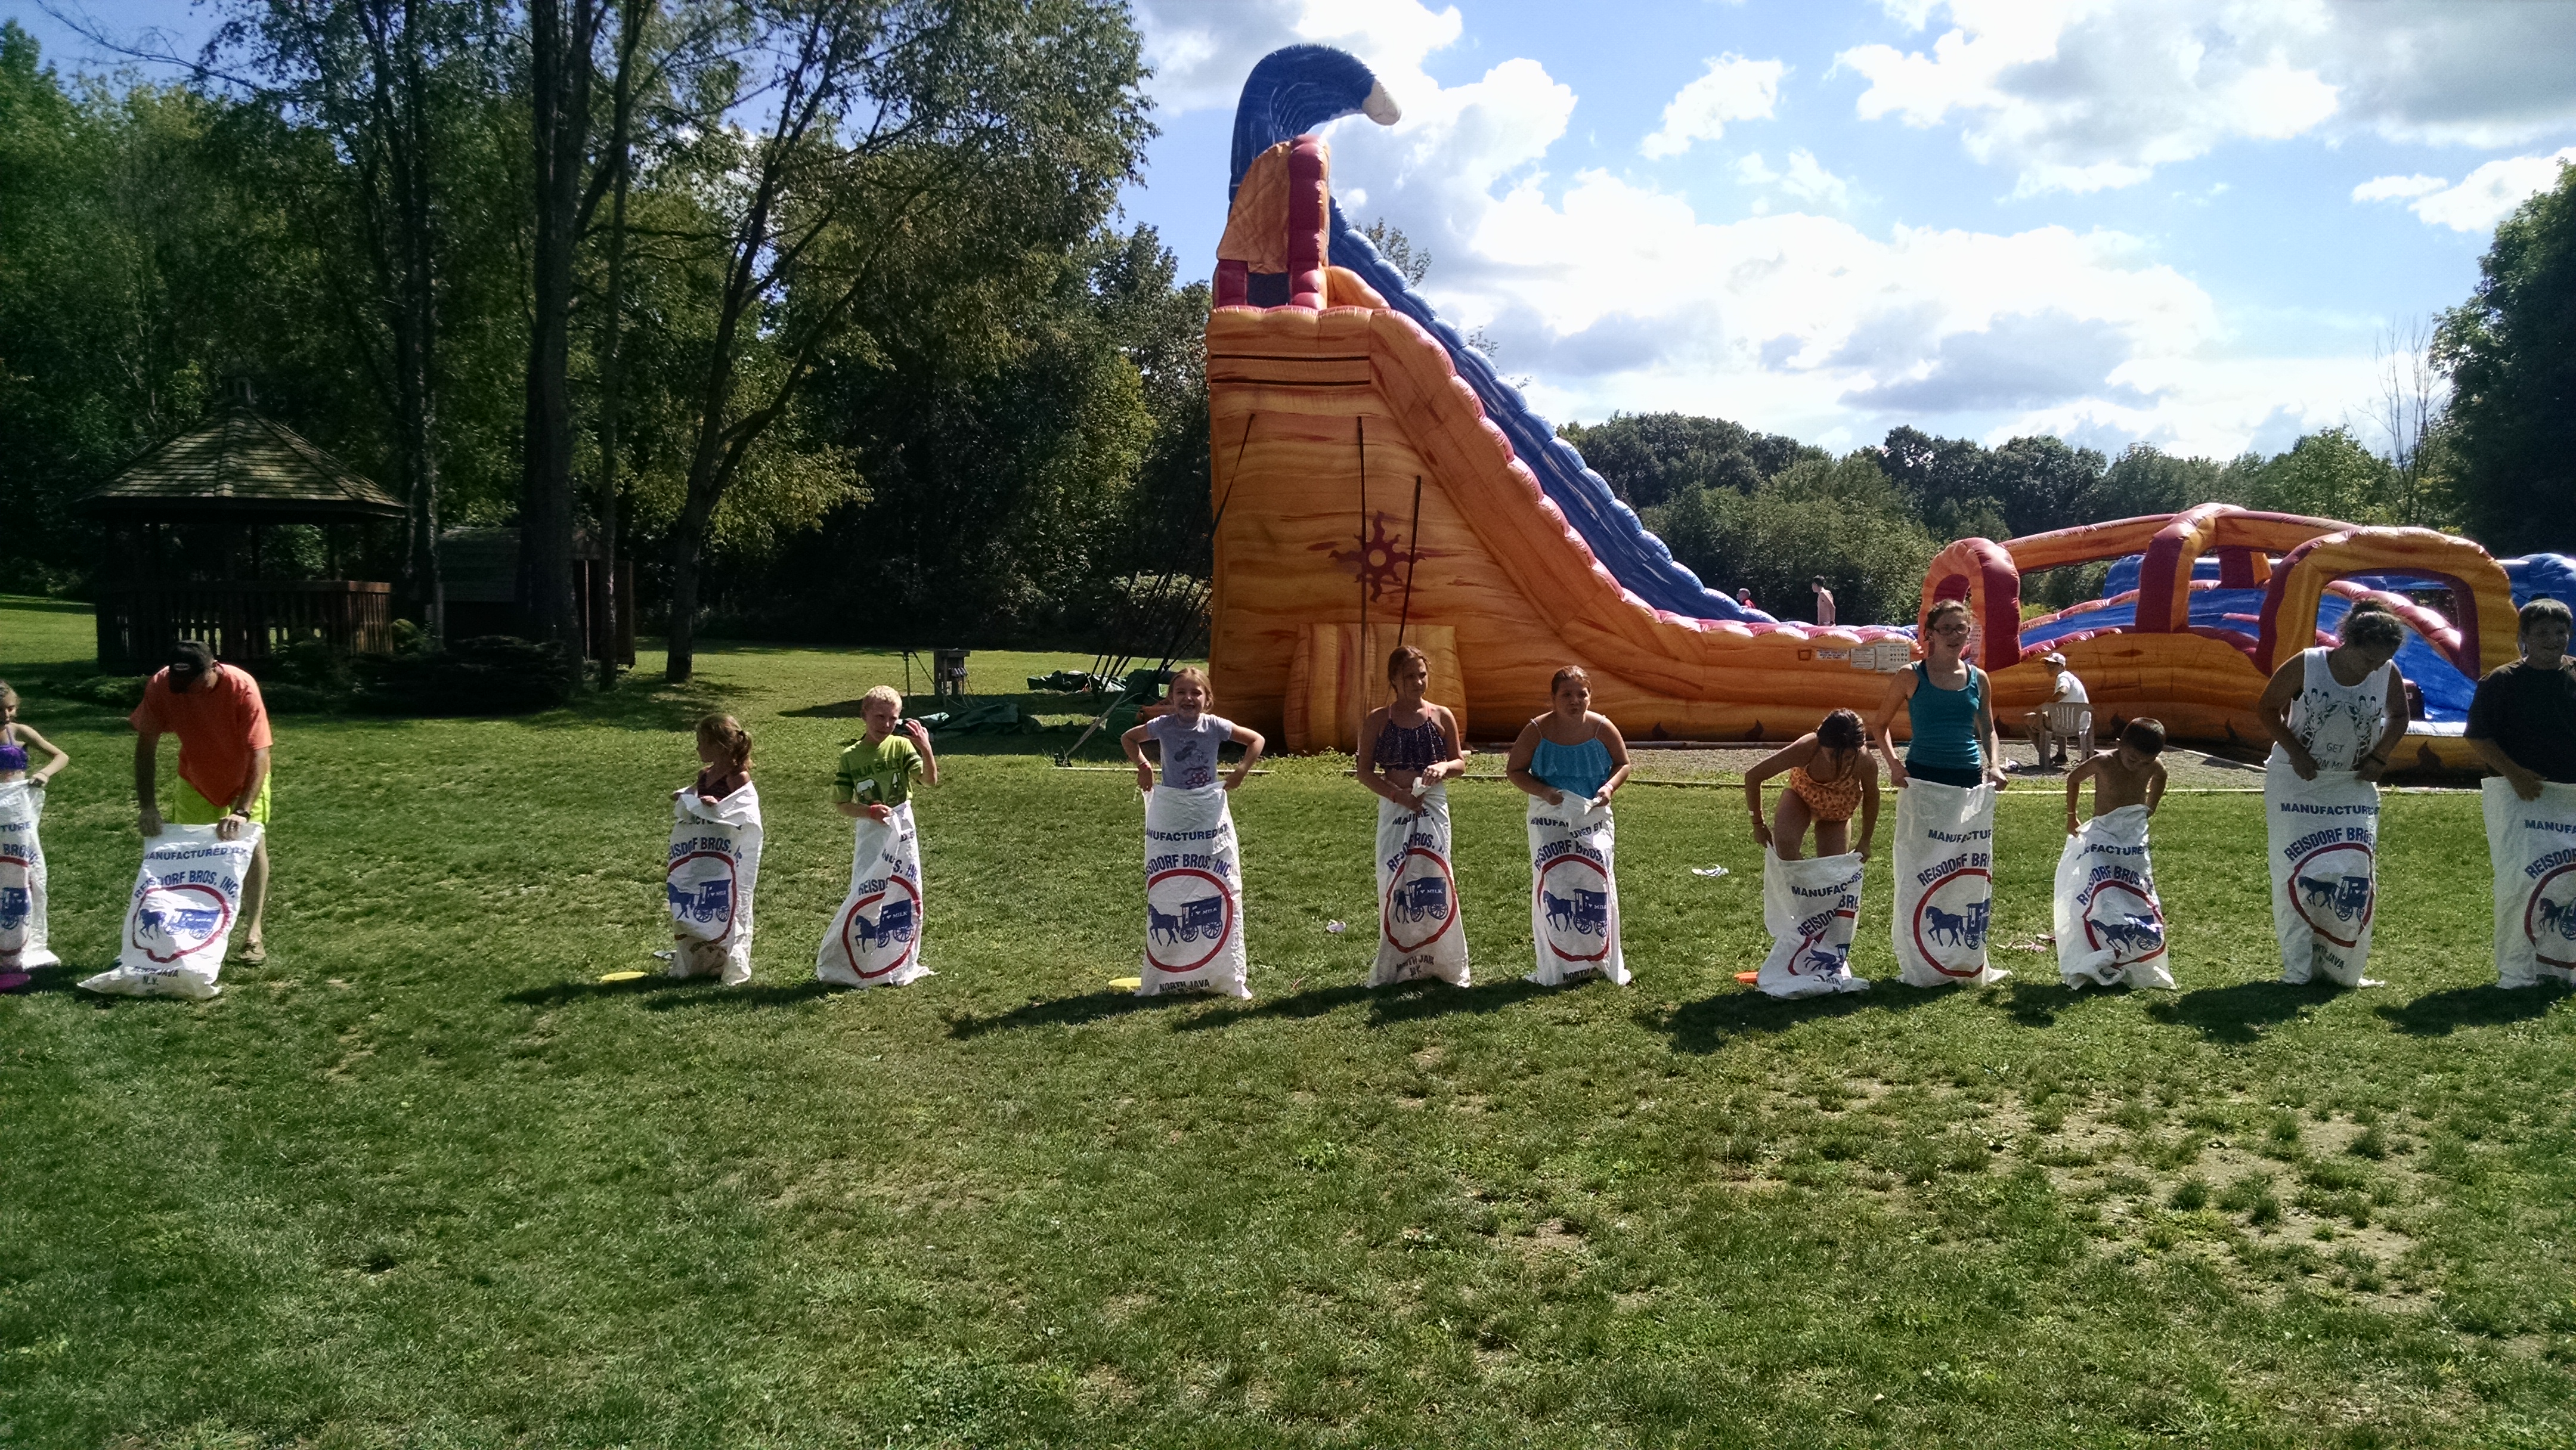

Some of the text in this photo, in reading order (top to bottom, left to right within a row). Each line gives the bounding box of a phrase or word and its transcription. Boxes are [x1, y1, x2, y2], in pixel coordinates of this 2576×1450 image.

[2327, 742, 2345, 752] GET
[1593, 819, 1603, 832] BY
[701, 836, 732, 853] BROS.
[2283, 828, 2343, 862] REISDORF
[1182, 853, 1211, 870] BROS.
[1213, 858, 1231, 881] INC.
[1916, 853, 1968, 887] REISDORF
[188, 870, 217, 887] BROS.
[219, 875, 240, 898] INC.
[2326, 952, 2345, 970] JAVA
[1159, 980, 1187, 992] NORTH
[1190, 978, 1210, 989] JAVA
